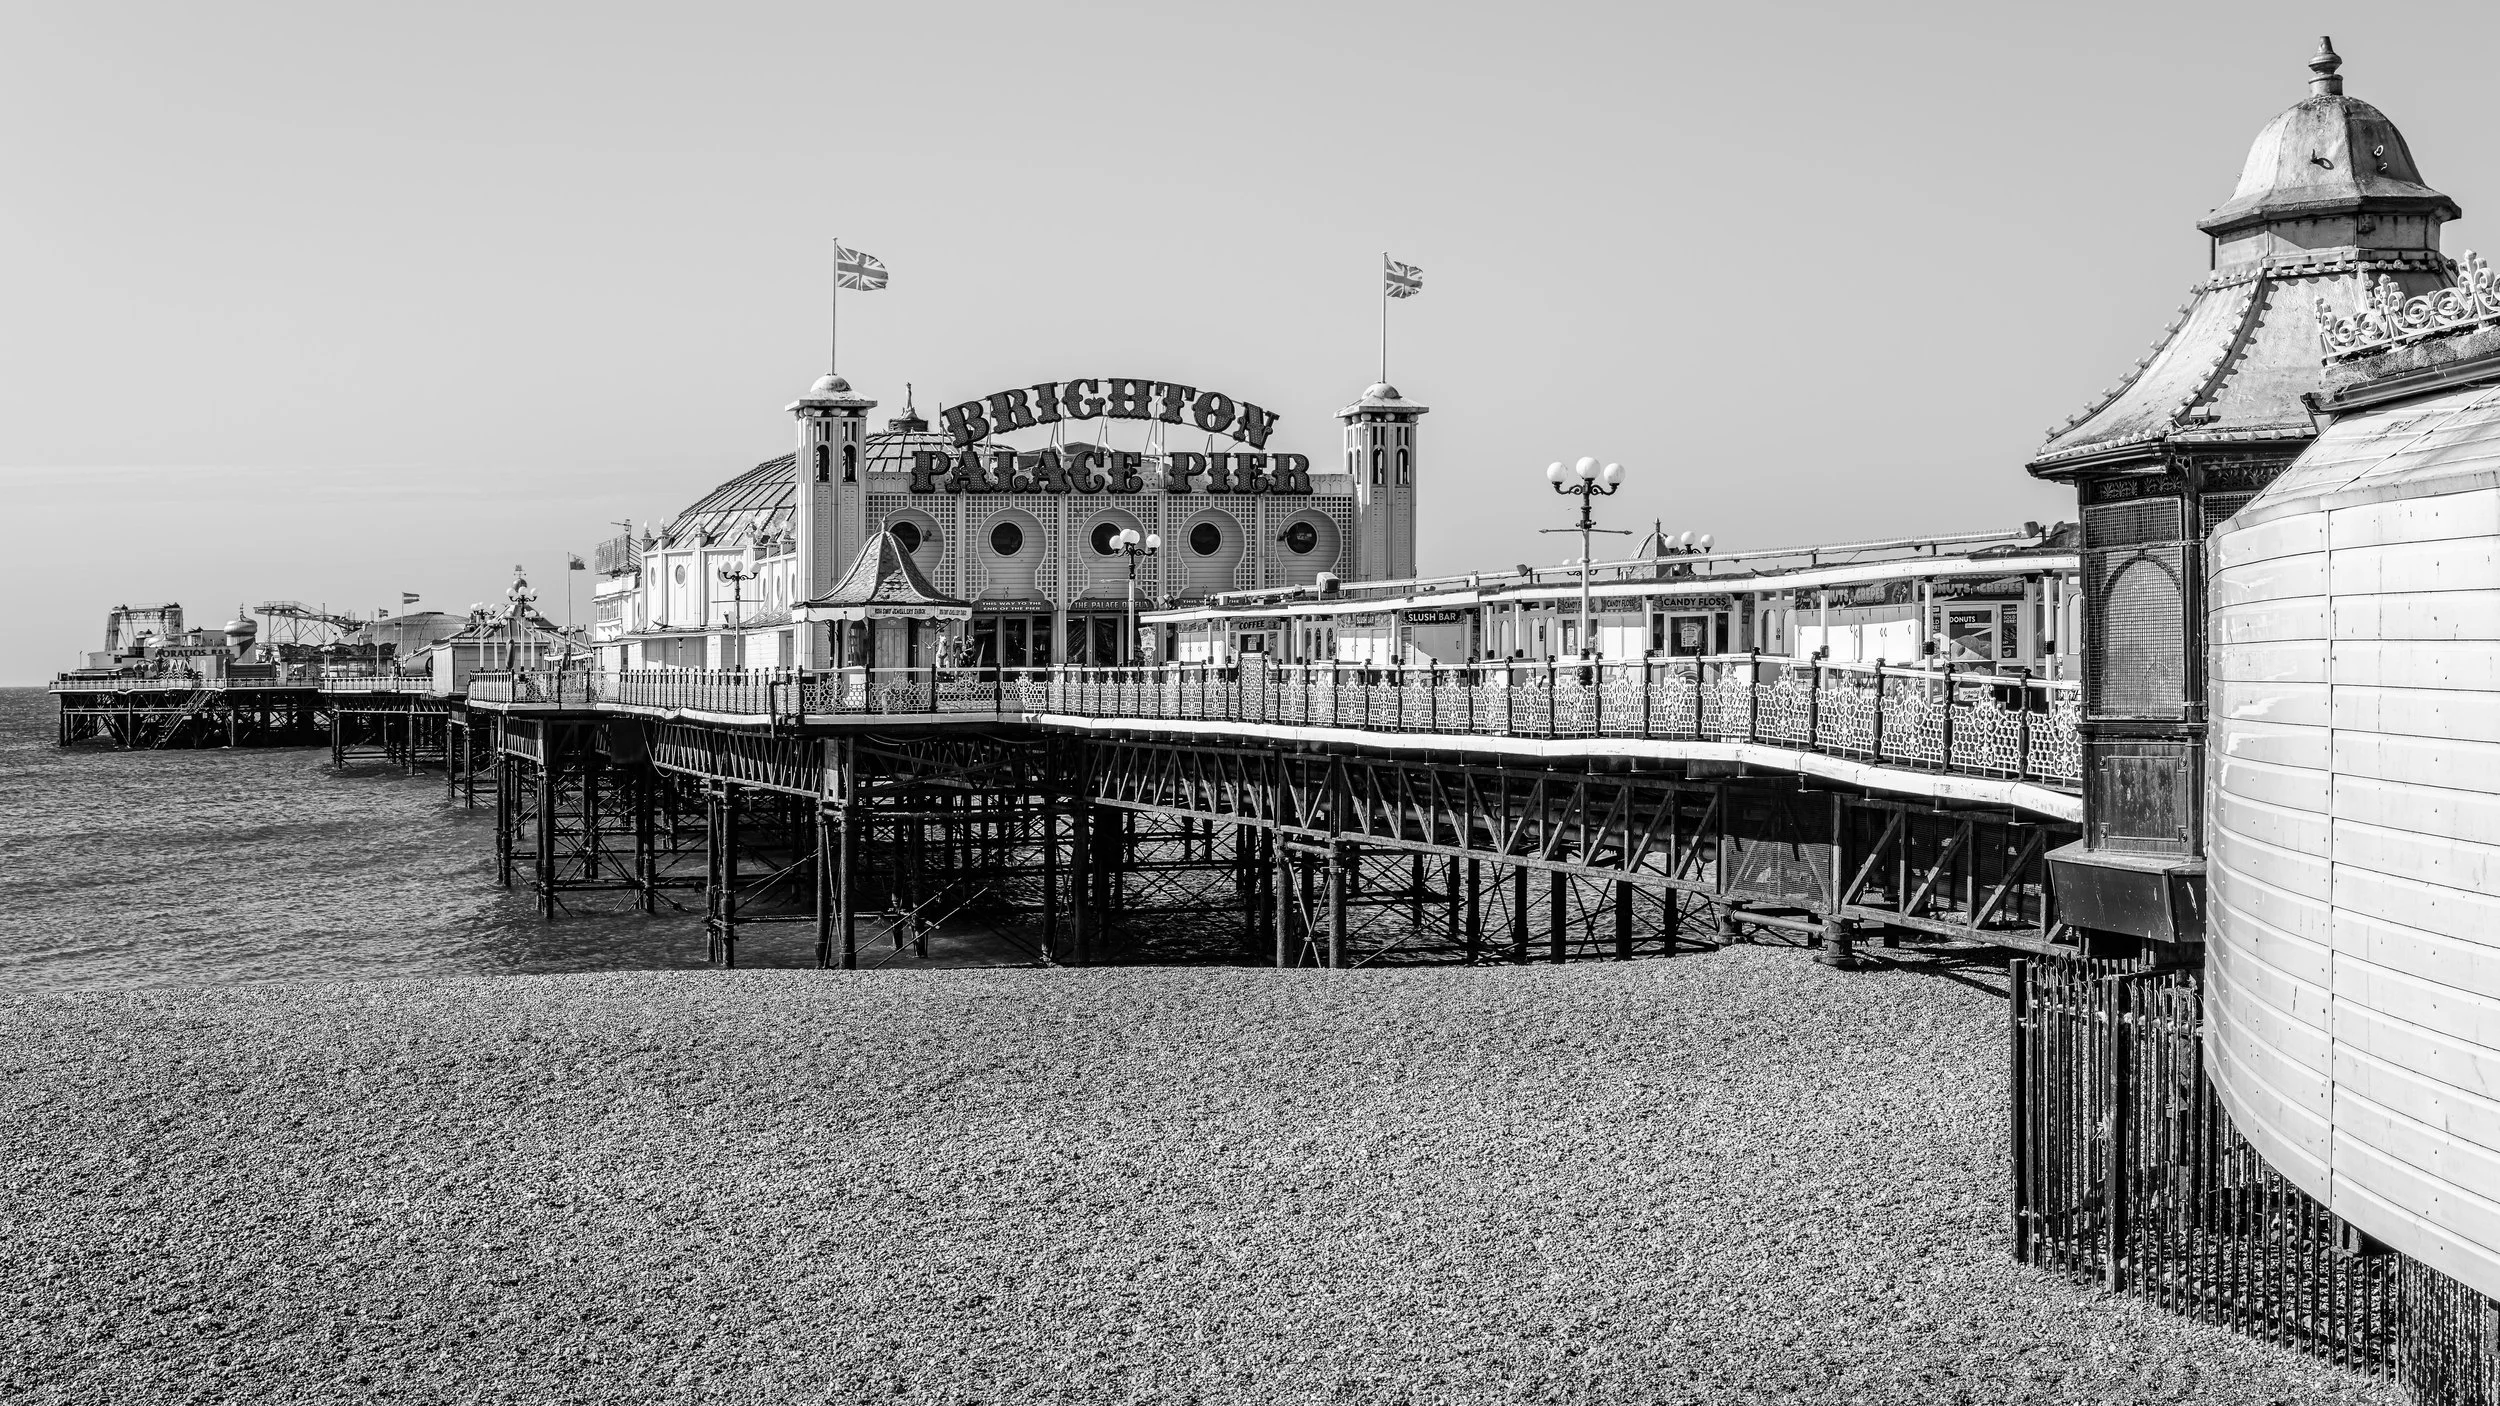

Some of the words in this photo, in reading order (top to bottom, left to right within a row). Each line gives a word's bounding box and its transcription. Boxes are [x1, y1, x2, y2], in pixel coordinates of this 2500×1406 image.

[941, 378, 1280, 449] BRIGHTON
[910, 450, 1143, 495] PALACE
[1167, 451, 1314, 496] PIER
[1979, 582, 2024, 594] CREPES
[1855, 586, 1886, 603] CREPES
[1091, 601, 1119, 609] PALACE
[1135, 601, 1150, 609] FUN
[1564, 600, 1578, 609] CANDY
[1606, 599, 1621, 608] CANDY
[1621, 598, 1635, 607] FLOSS
[1663, 597, 1697, 607] CANDY
[1698, 597, 1727, 607] FLOSS
[1407, 611, 1436, 622] SLUSH
[1438, 611, 1457, 621] BAR
[1949, 615, 1976, 623] DONUTS
[1239, 620, 1265, 630] COFFEE
[155, 649, 207, 658] ORATIOS
